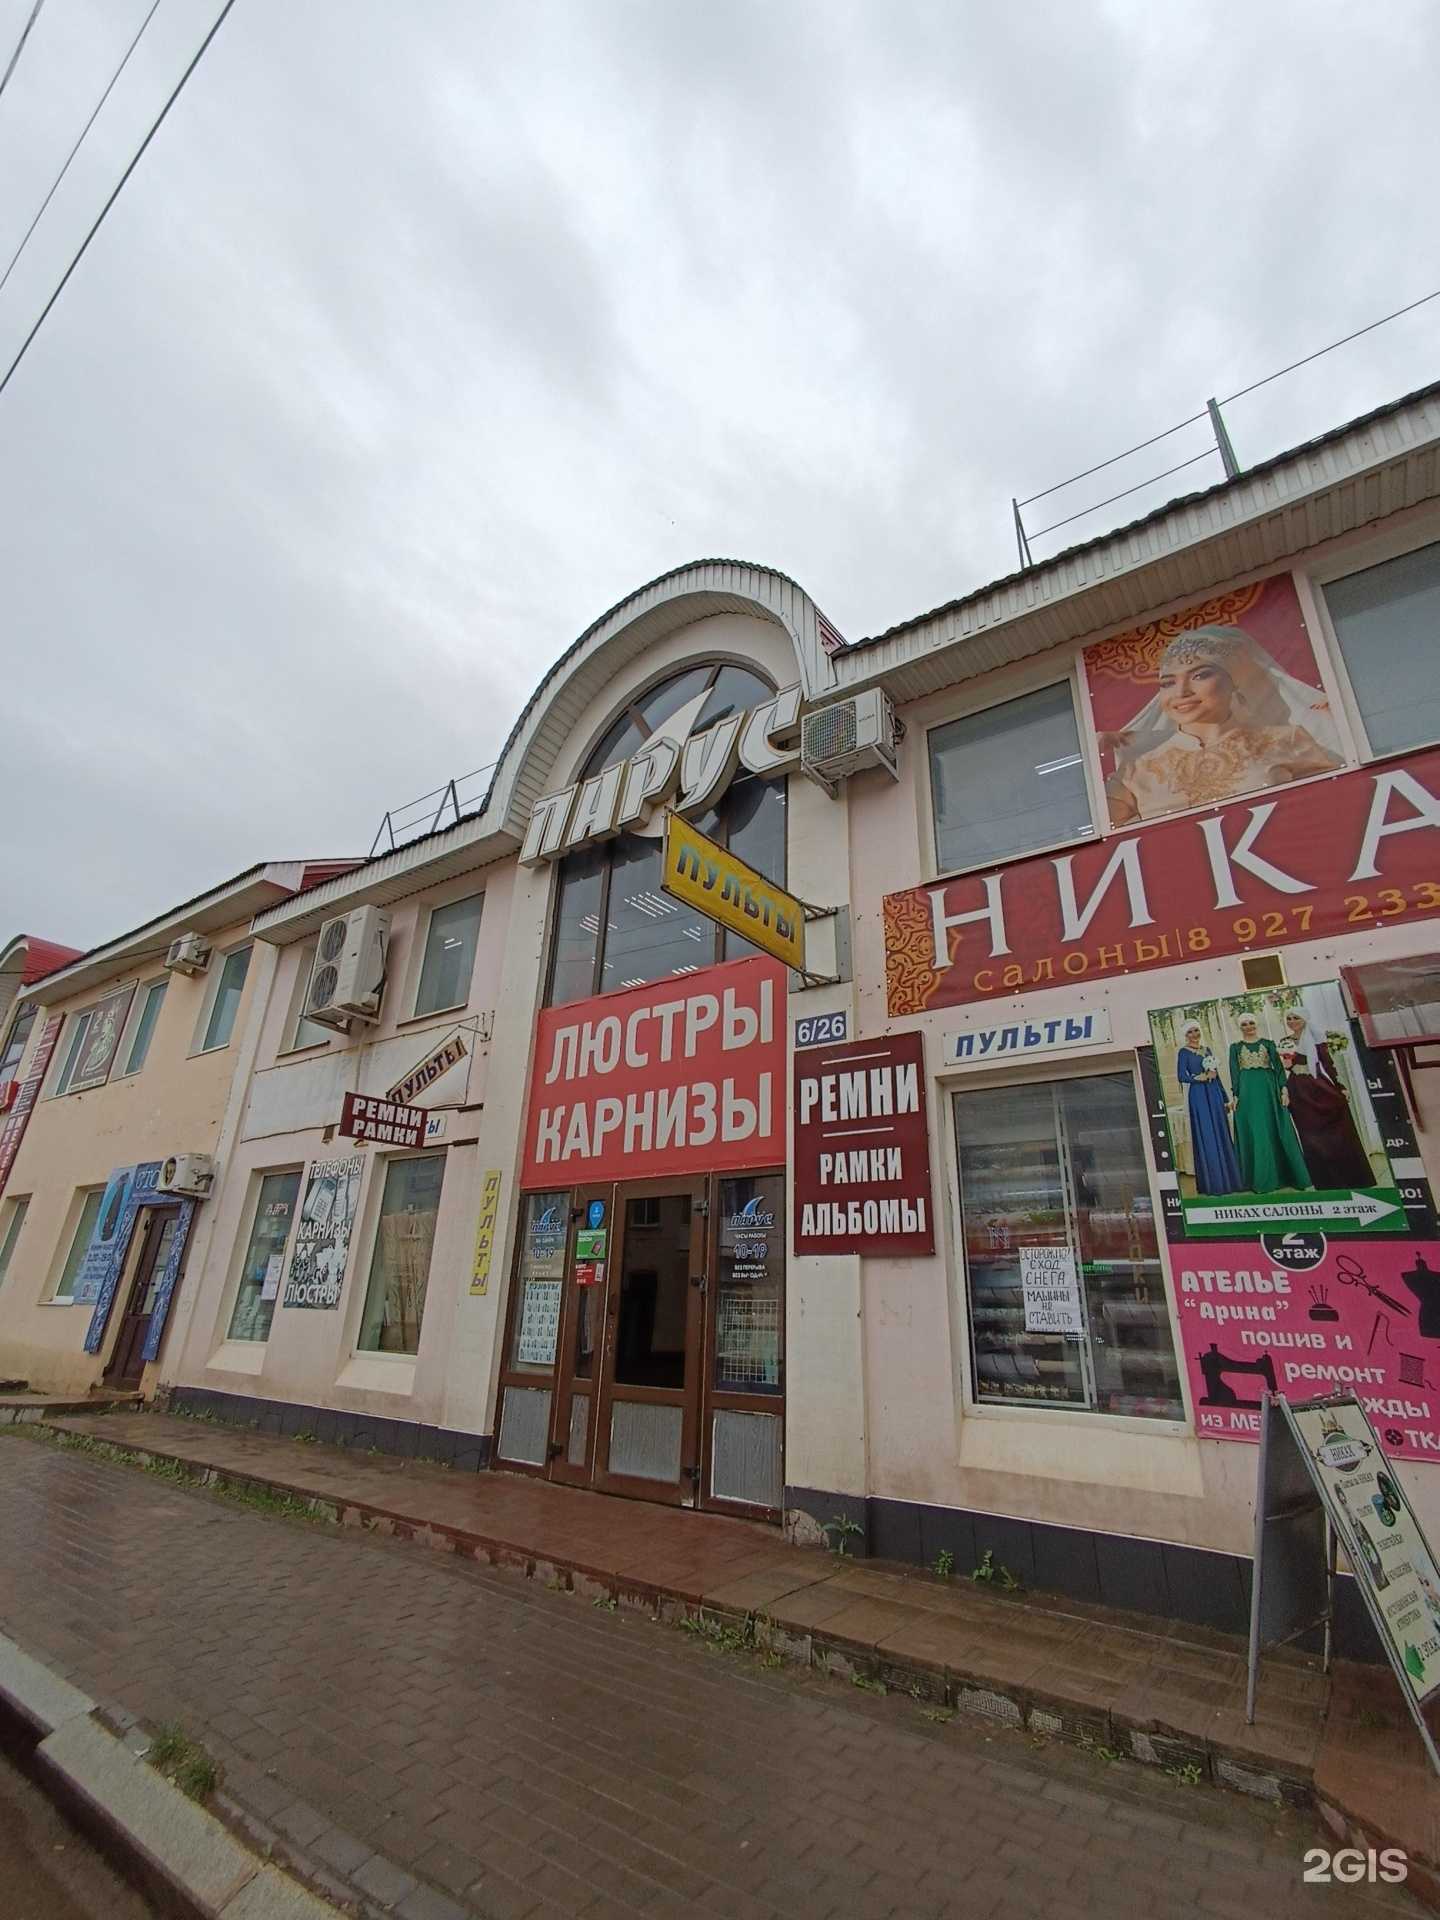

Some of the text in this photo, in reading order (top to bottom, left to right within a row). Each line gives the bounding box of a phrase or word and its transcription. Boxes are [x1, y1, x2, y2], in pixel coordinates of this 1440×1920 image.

[518, 680, 802, 870] ПАРУС
[928, 769, 1440, 969] НИКА
[675, 842, 796, 944] ПУЛЬТЫ
[1234, 904, 1314, 942] 927
[1345, 880, 1440, 922] 233
[546, 979, 774, 1085] ЛЮСТРЫ
[797, 1016, 846, 1045] 6/26
[955, 1015, 1094, 1058] ПУЛЬТЫ
[391, 1041, 463, 1105] ПУЛЬТЫ
[799, 1062, 921, 1126] РЕМНИ
[351, 1097, 424, 1128] РЕМНИ
[535, 1072, 773, 1164] КАРНИЗЫ
[351, 1119, 419, 1146] РАМКИ
[309, 1158, 364, 1180] ТЕЛЕФОНЫ
[819, 1147, 904, 1186] РАМКИ
[800, 1197, 927, 1238] АЛЬБОМЫ
[1213, 1204, 1379, 1220] НИКАХ САЛОНЫ 2 этаж
[297, 1219, 352, 1241] КАРНИЗЫ
[471, 1176, 499, 1288] ПУЛЬТЫ
[733, 1242, 768, 1260] 10-19
[1030, 1259, 1061, 1270] СХОД
[1272, 1248, 1321, 1260] этаж
[1025, 1271, 1066, 1285] СНЕГА
[1181, 1270, 1292, 1294] АТЕЛЬЕ
[284, 1282, 341, 1305] ЛЮСТРЫ
[1027, 1289, 1070, 1302] МАШИНЫ
[1028, 1311, 1073, 1325] СТАВИТЬ
[1240, 1330, 1353, 1351] пошив и
[1284, 1362, 1386, 1384] ремонт
